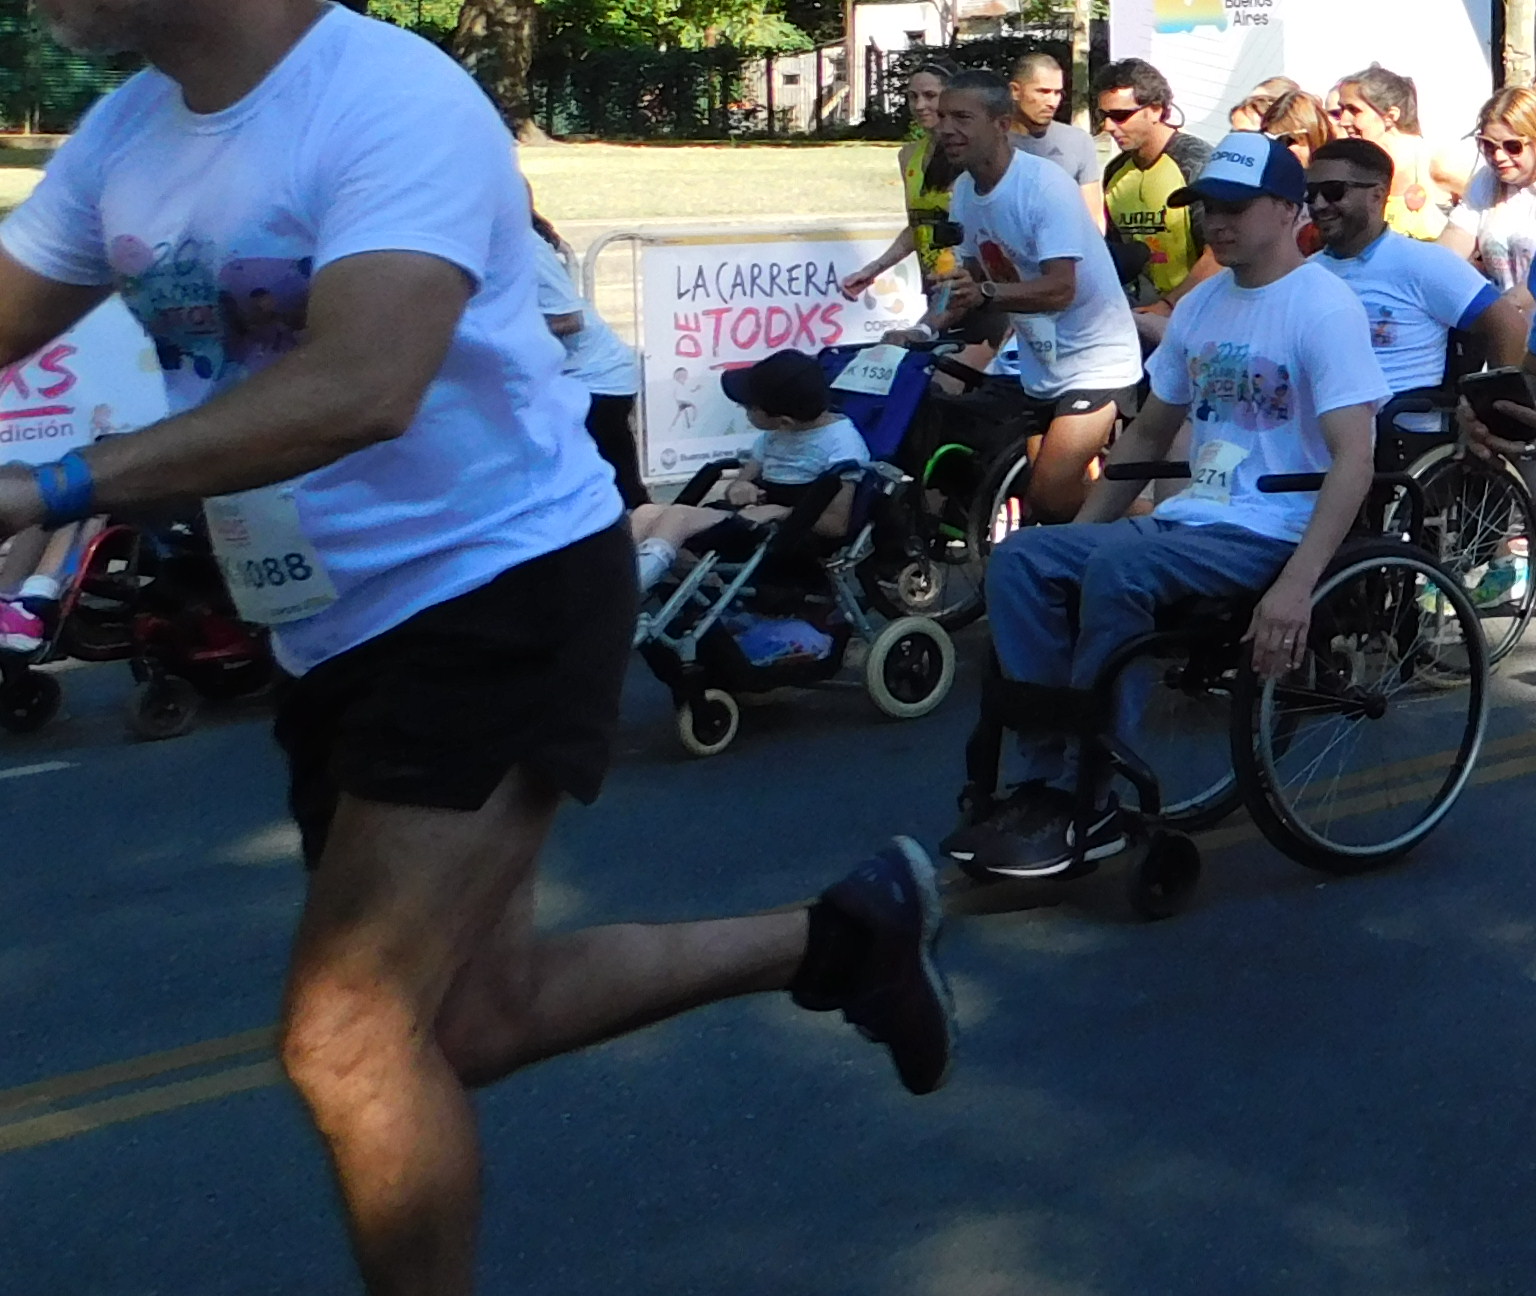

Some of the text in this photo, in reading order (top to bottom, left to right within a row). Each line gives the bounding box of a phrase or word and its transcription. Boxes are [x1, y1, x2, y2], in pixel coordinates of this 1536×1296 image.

[1232, 9, 1269, 28] Aires
[673, 303, 845, 358] DE TODXS
